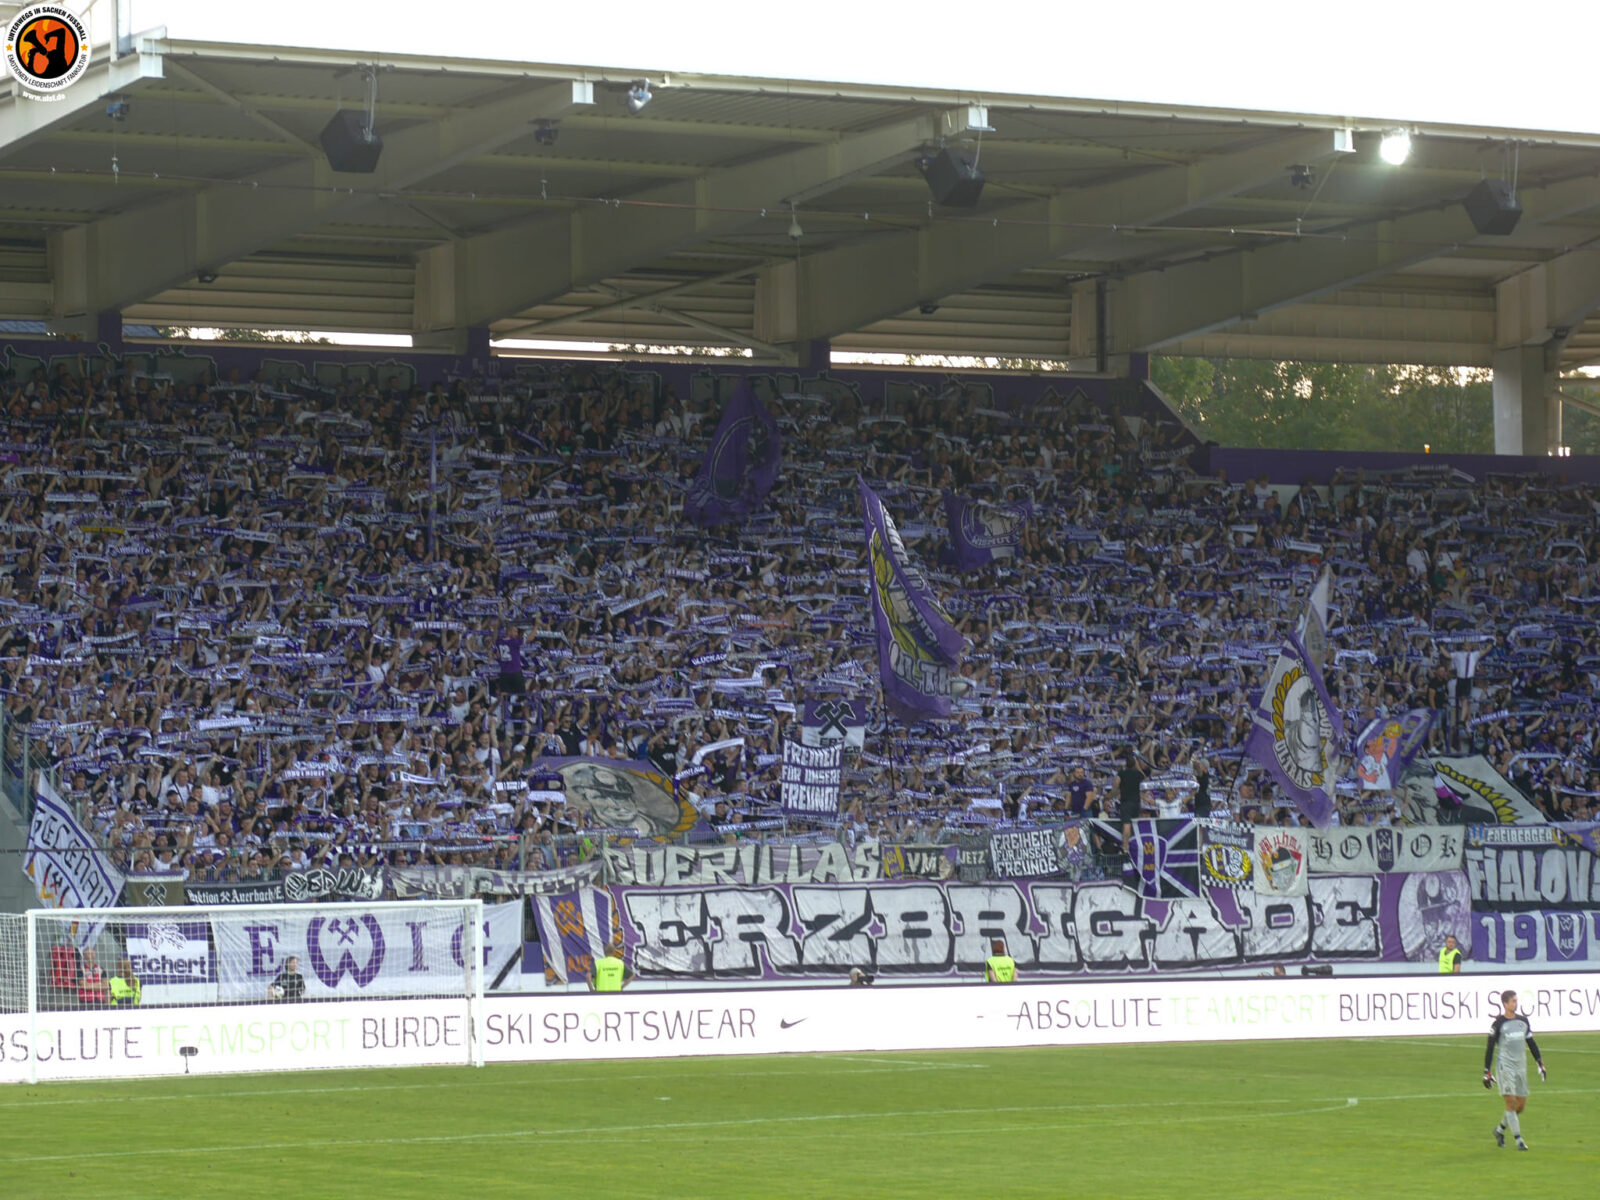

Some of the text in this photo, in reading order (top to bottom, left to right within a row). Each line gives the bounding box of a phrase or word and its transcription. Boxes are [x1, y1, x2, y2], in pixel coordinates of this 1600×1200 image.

[1273, 740, 1313, 791] ULTRAS
[992, 829, 1054, 850] FREIHEIT
[601, 842, 881, 886] GUERILLAS
[996, 855, 1059, 878] FREUNDE
[623, 875, 1384, 980] ERZBRIGADE
[129, 954, 206, 976] Eichert
[1008, 988, 1600, 1031] ABSOLUTE TEAMSPORT BURDENSKI SORTSW
[150, 1018, 351, 1057] TEAMSPORT
[543, 1008, 756, 1044] SPORTSWEAR
